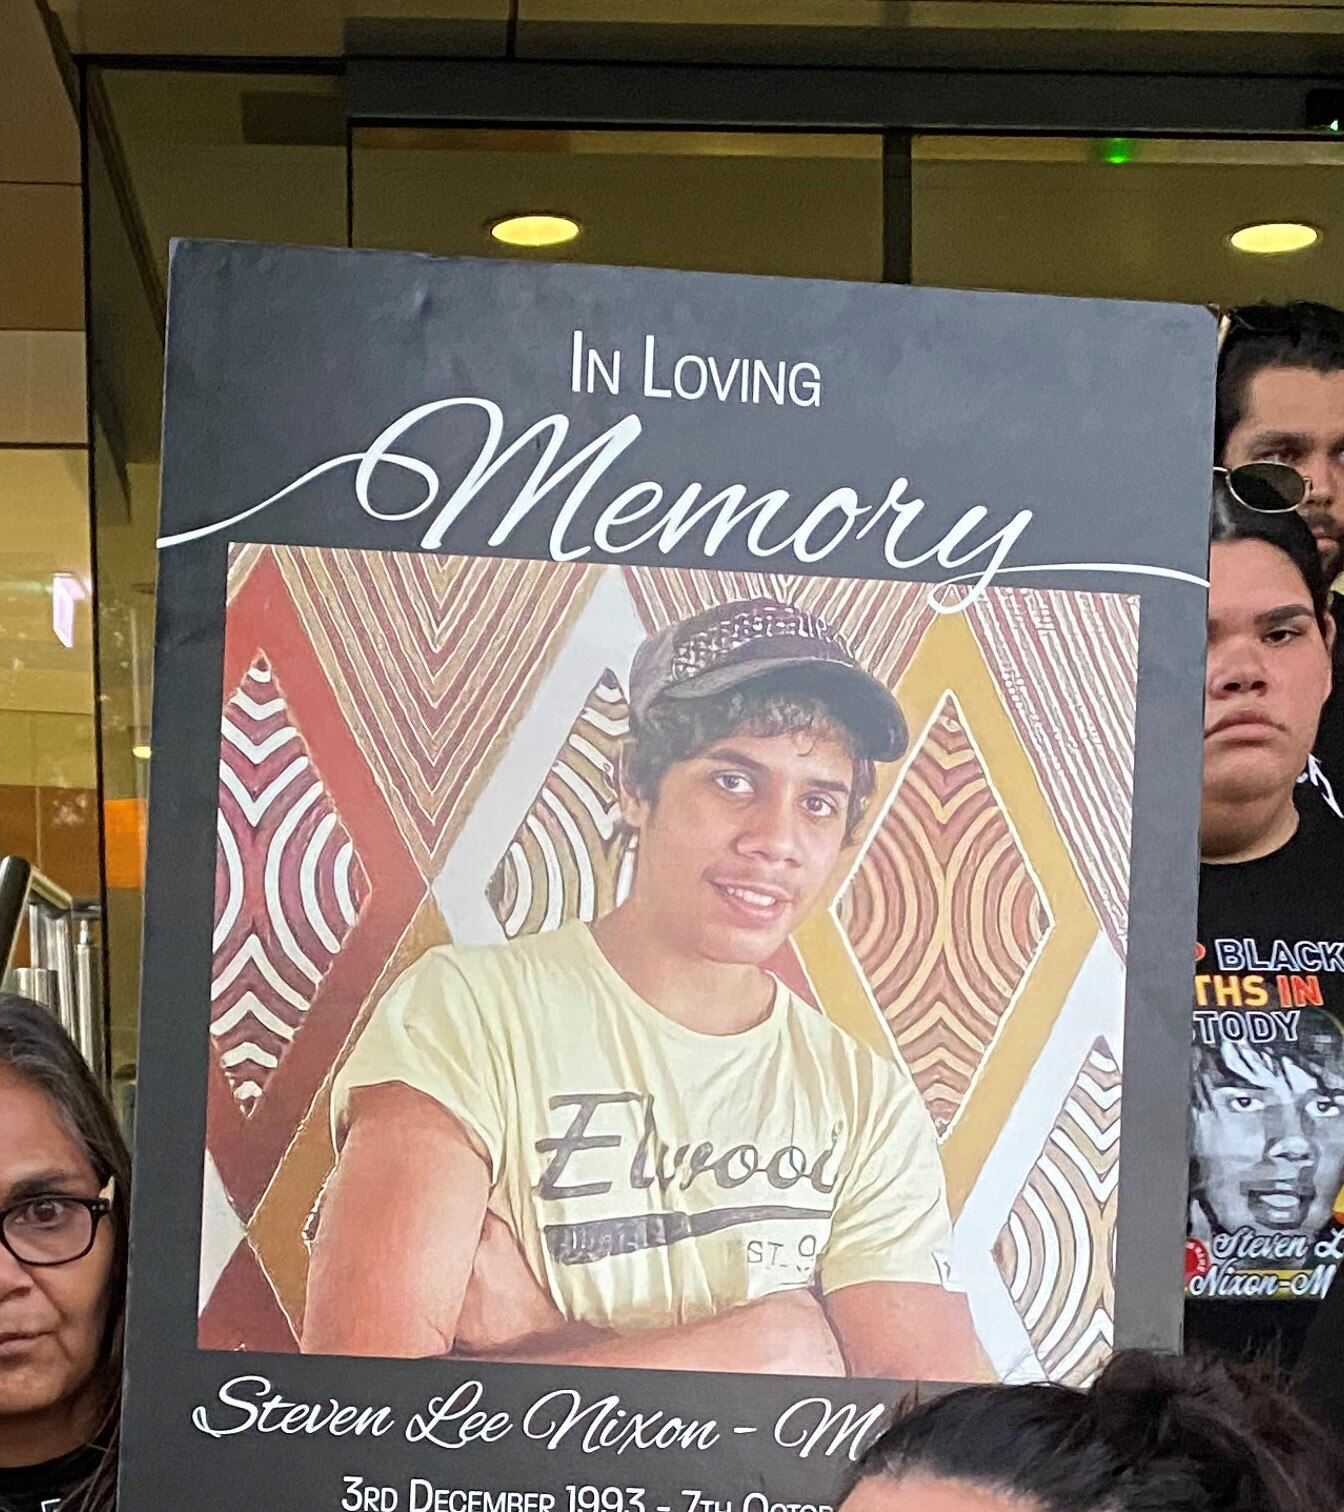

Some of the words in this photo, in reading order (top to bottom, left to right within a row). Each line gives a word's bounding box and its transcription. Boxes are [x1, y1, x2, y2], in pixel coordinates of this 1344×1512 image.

[346, 396, 1046, 614] Memory
[1194, 974, 1269, 1007] THS
[1276, 974, 1324, 1008] IN
[1192, 1009, 1301, 1045] TODY
[1213, 1225, 1309, 1259] Steven
[1189, 1258, 1338, 1300] Nixon-M
[192, 1375, 395, 1438] Steven
[405, 1380, 514, 1449] Lee
[523, 1389, 721, 1455] Nixon
